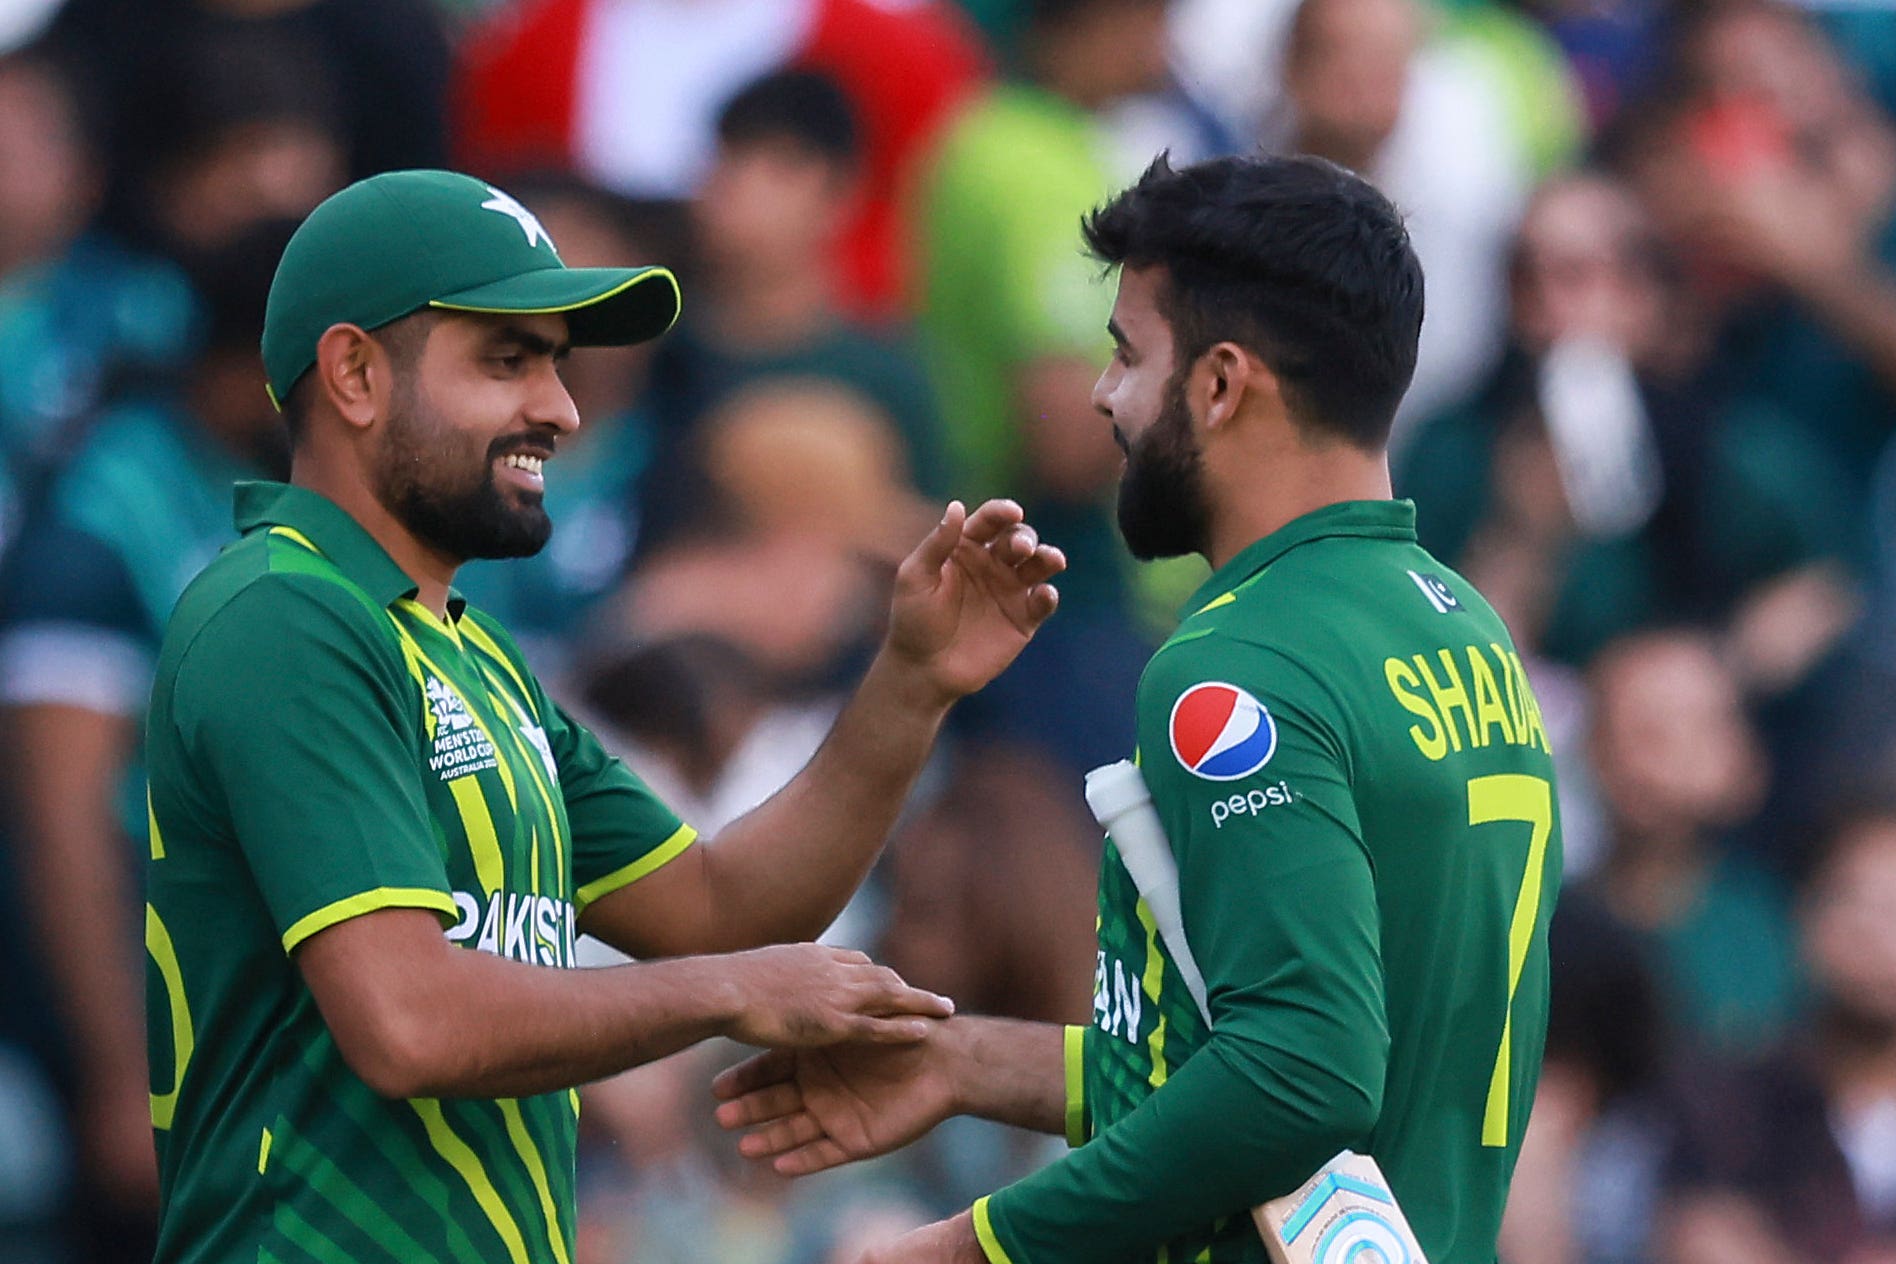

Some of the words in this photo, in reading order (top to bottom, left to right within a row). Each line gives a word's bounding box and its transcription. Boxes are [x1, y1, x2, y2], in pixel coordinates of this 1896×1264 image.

[429, 745, 478, 771] WORLD
[440, 760, 485, 781] AUSTRALIA
[1211, 780, 1293, 829] pepsi
[1467, 773, 1552, 1148] 7
